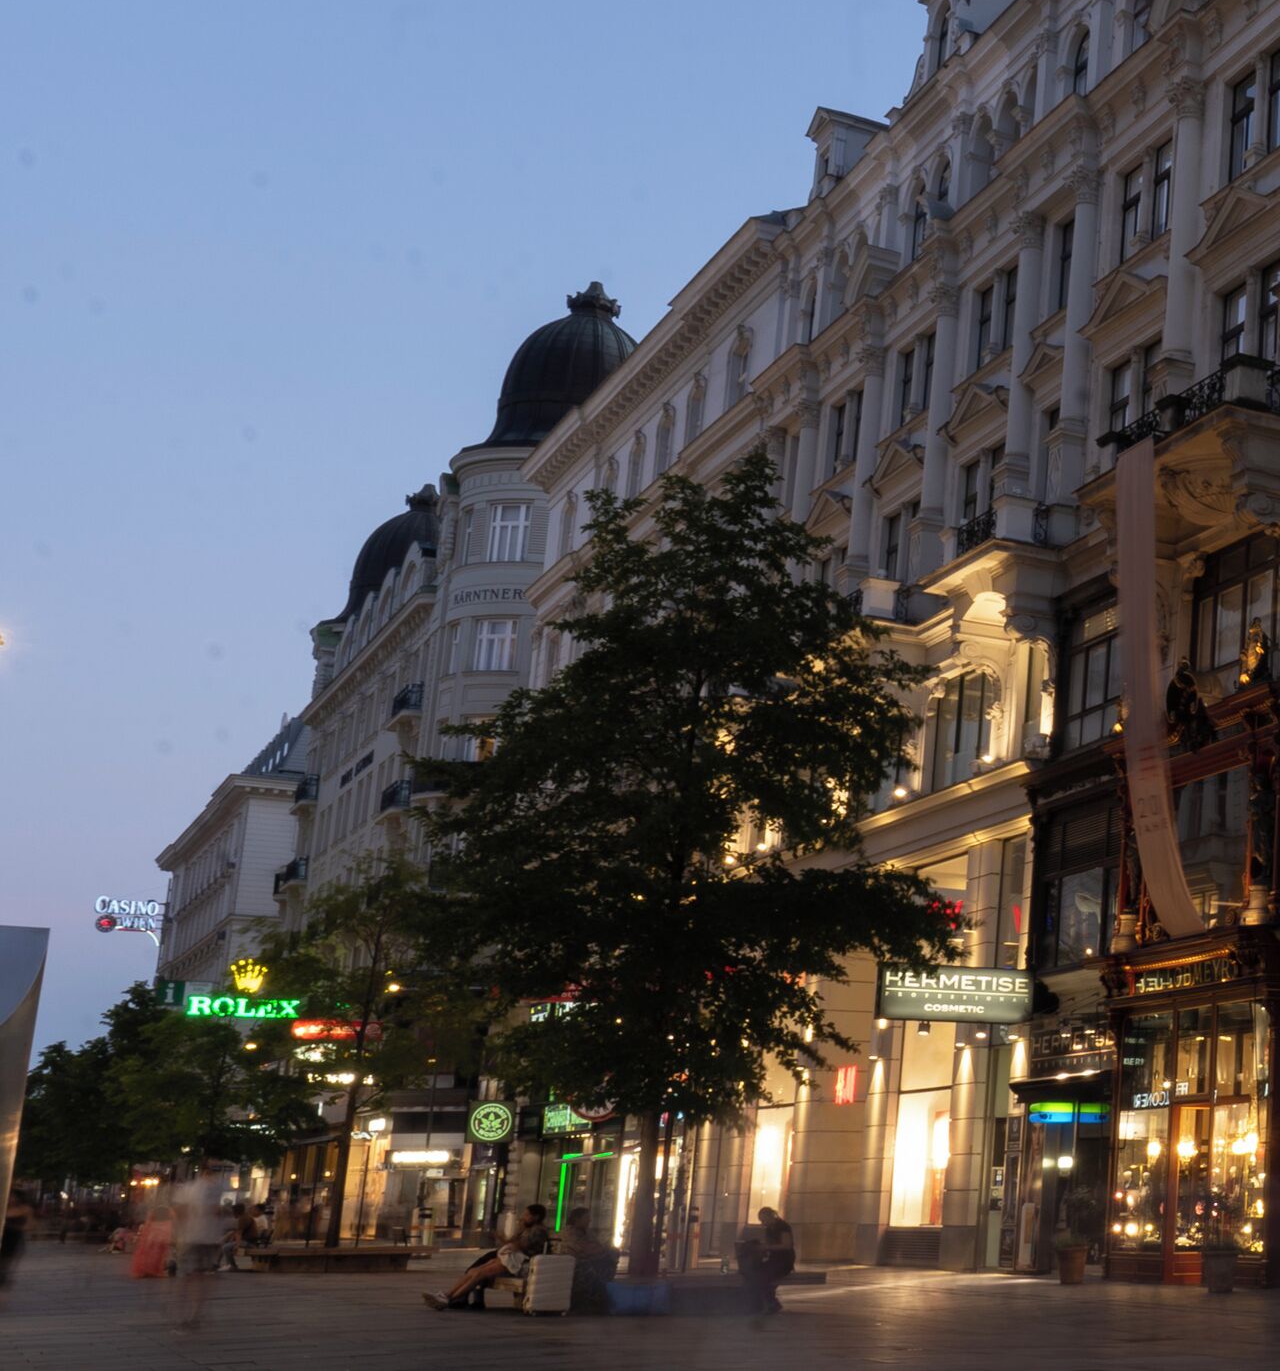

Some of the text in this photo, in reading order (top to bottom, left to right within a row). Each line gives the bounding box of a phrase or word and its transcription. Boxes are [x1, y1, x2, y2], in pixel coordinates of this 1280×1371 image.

[95, 895, 159, 916] CASINO
[121, 916, 156, 930] WIEN
[884, 991, 1030, 1004] PROFESSIONAL
[187, 995, 301, 1019] ROLEX
[924, 1003, 986, 1014] COSMETIC
